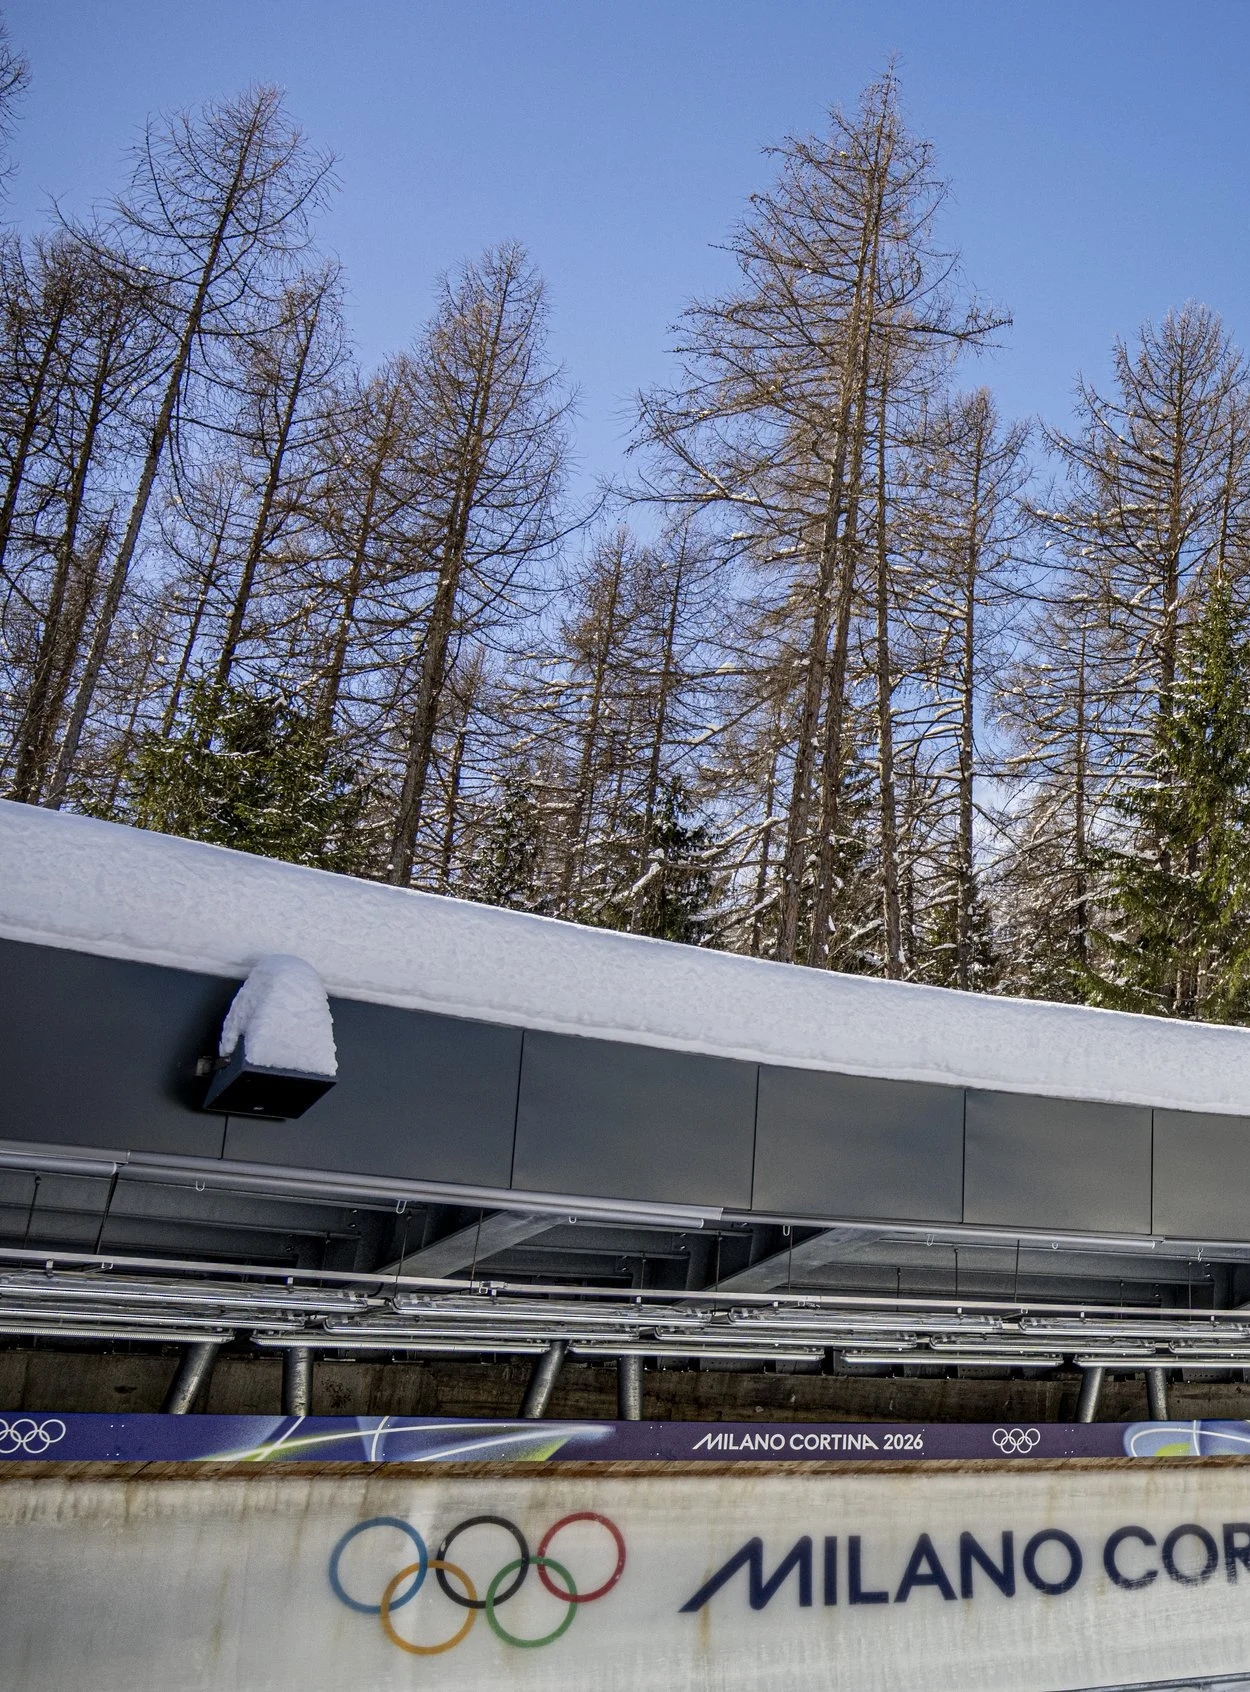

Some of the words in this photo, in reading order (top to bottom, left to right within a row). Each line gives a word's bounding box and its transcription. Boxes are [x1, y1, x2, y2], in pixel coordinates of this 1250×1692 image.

[692, 1433, 786, 1450] MILANO
[789, 1433, 879, 1450] CORTINA
[883, 1433, 924, 1450] 2026
[678, 1528, 1083, 1613] MILANO
